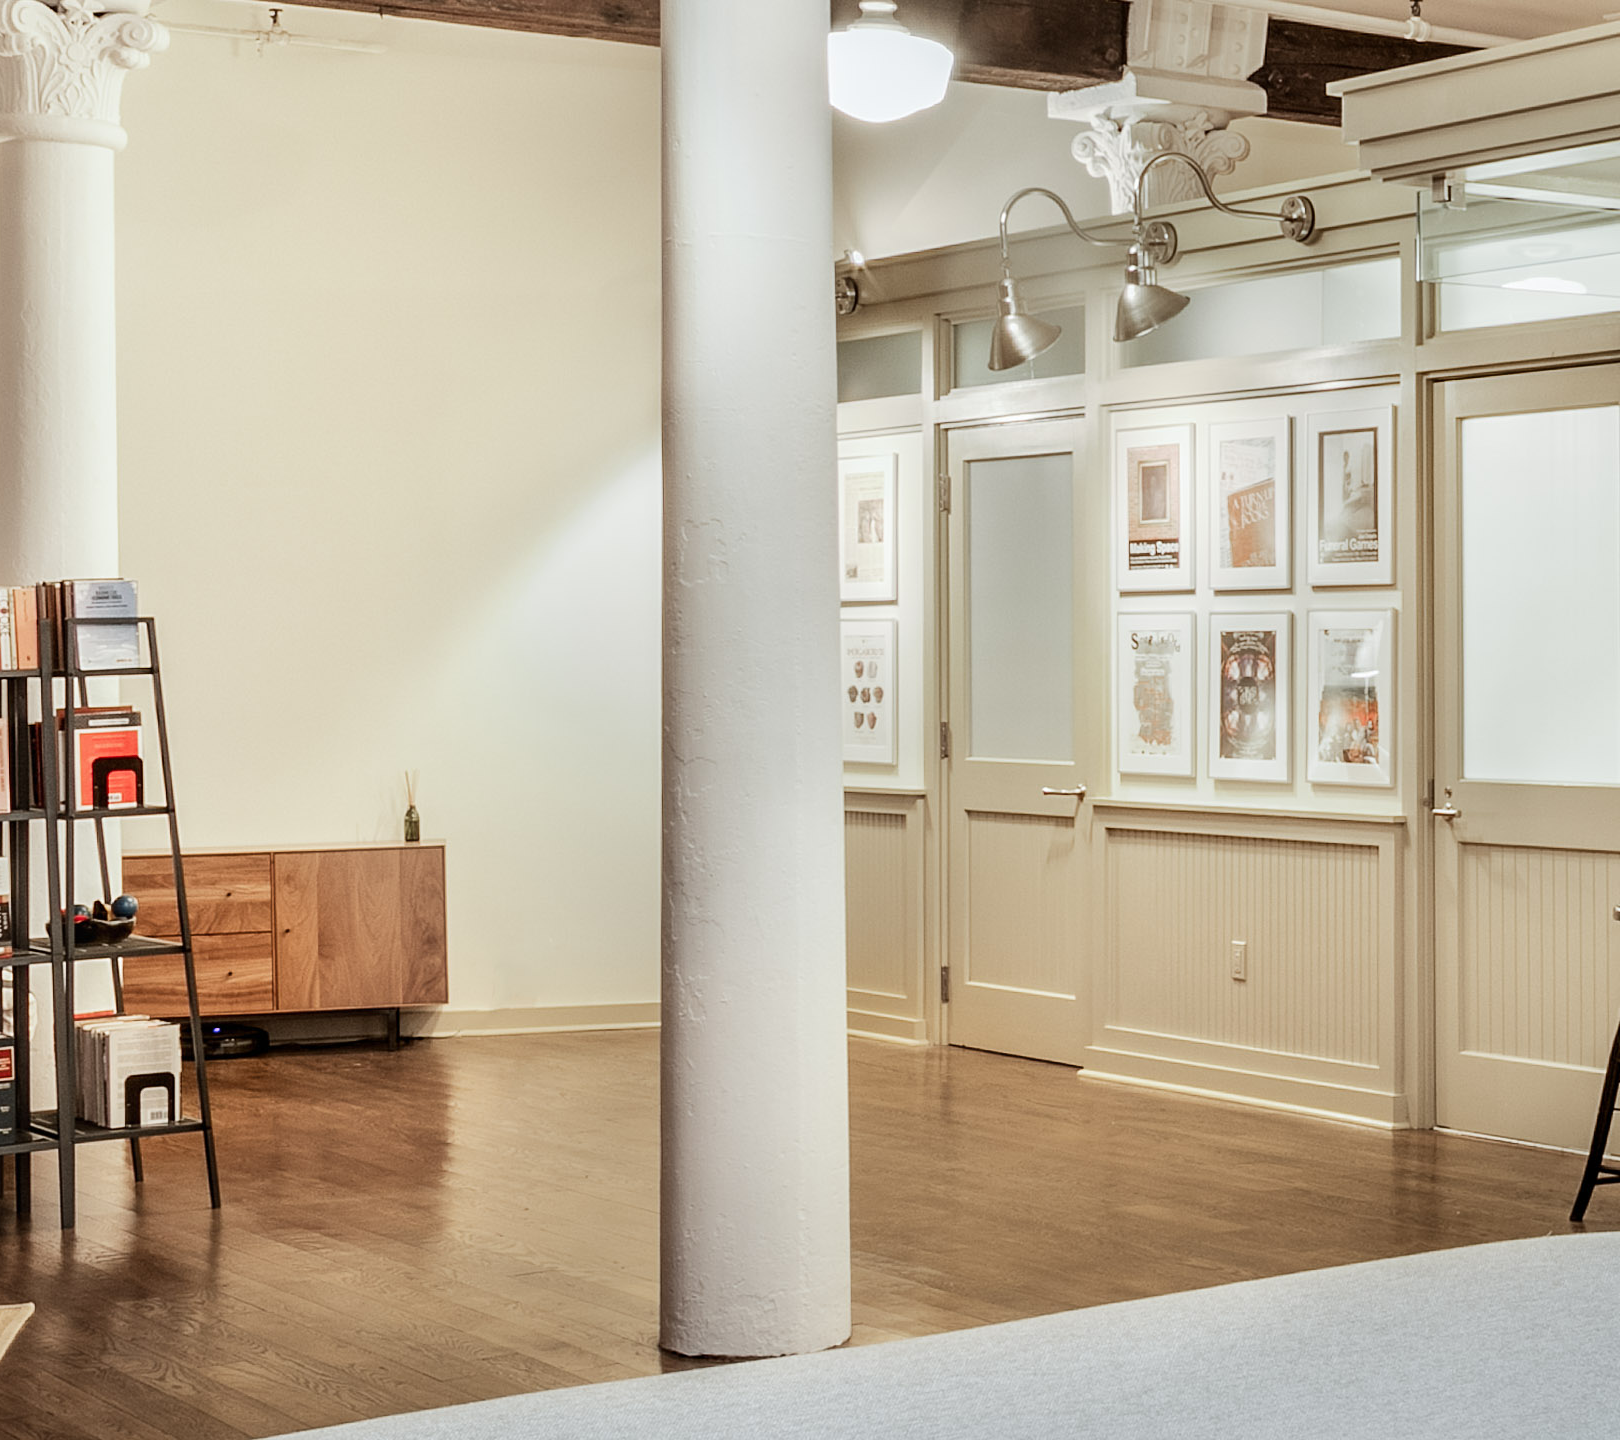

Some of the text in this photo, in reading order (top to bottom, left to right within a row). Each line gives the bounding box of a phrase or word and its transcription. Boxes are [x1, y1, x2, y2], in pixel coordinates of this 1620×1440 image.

[1129, 541, 1156, 555] Making
[1319, 536, 1379, 552] Funeral Games
